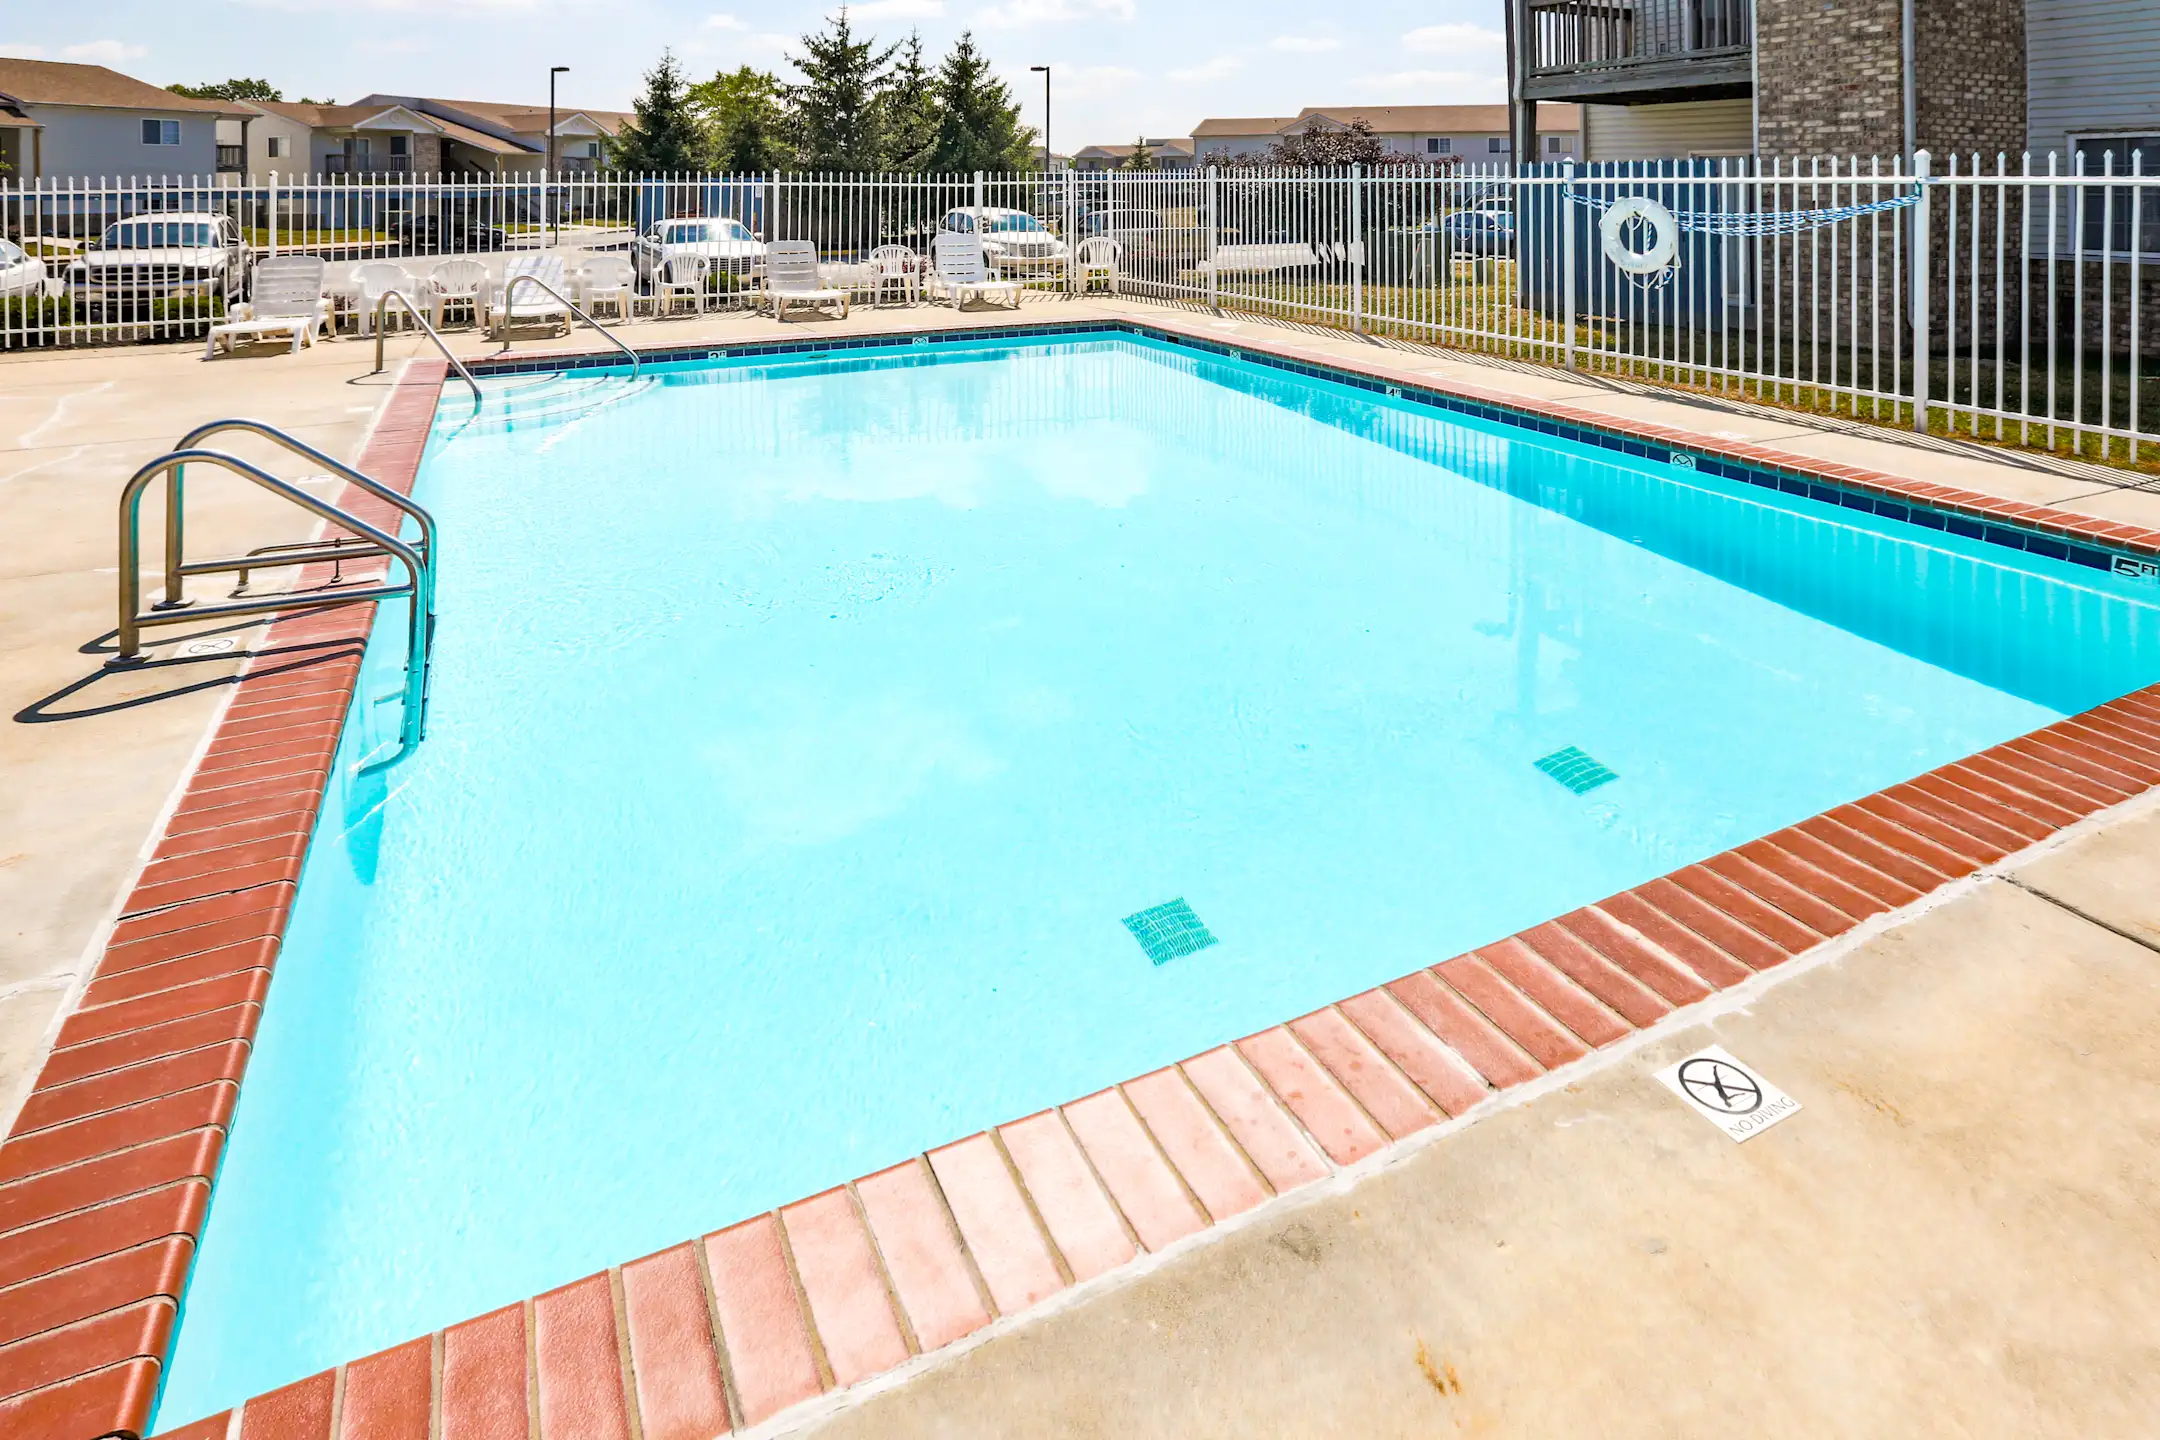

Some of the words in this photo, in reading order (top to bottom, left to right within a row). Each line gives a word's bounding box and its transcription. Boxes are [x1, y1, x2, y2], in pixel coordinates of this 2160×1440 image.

[2113, 557, 2141, 578] 5
[2141, 563, 2158, 576] FT
[1728, 1119, 1753, 1136] NO
[1749, 1096, 1796, 1125] DIVING
